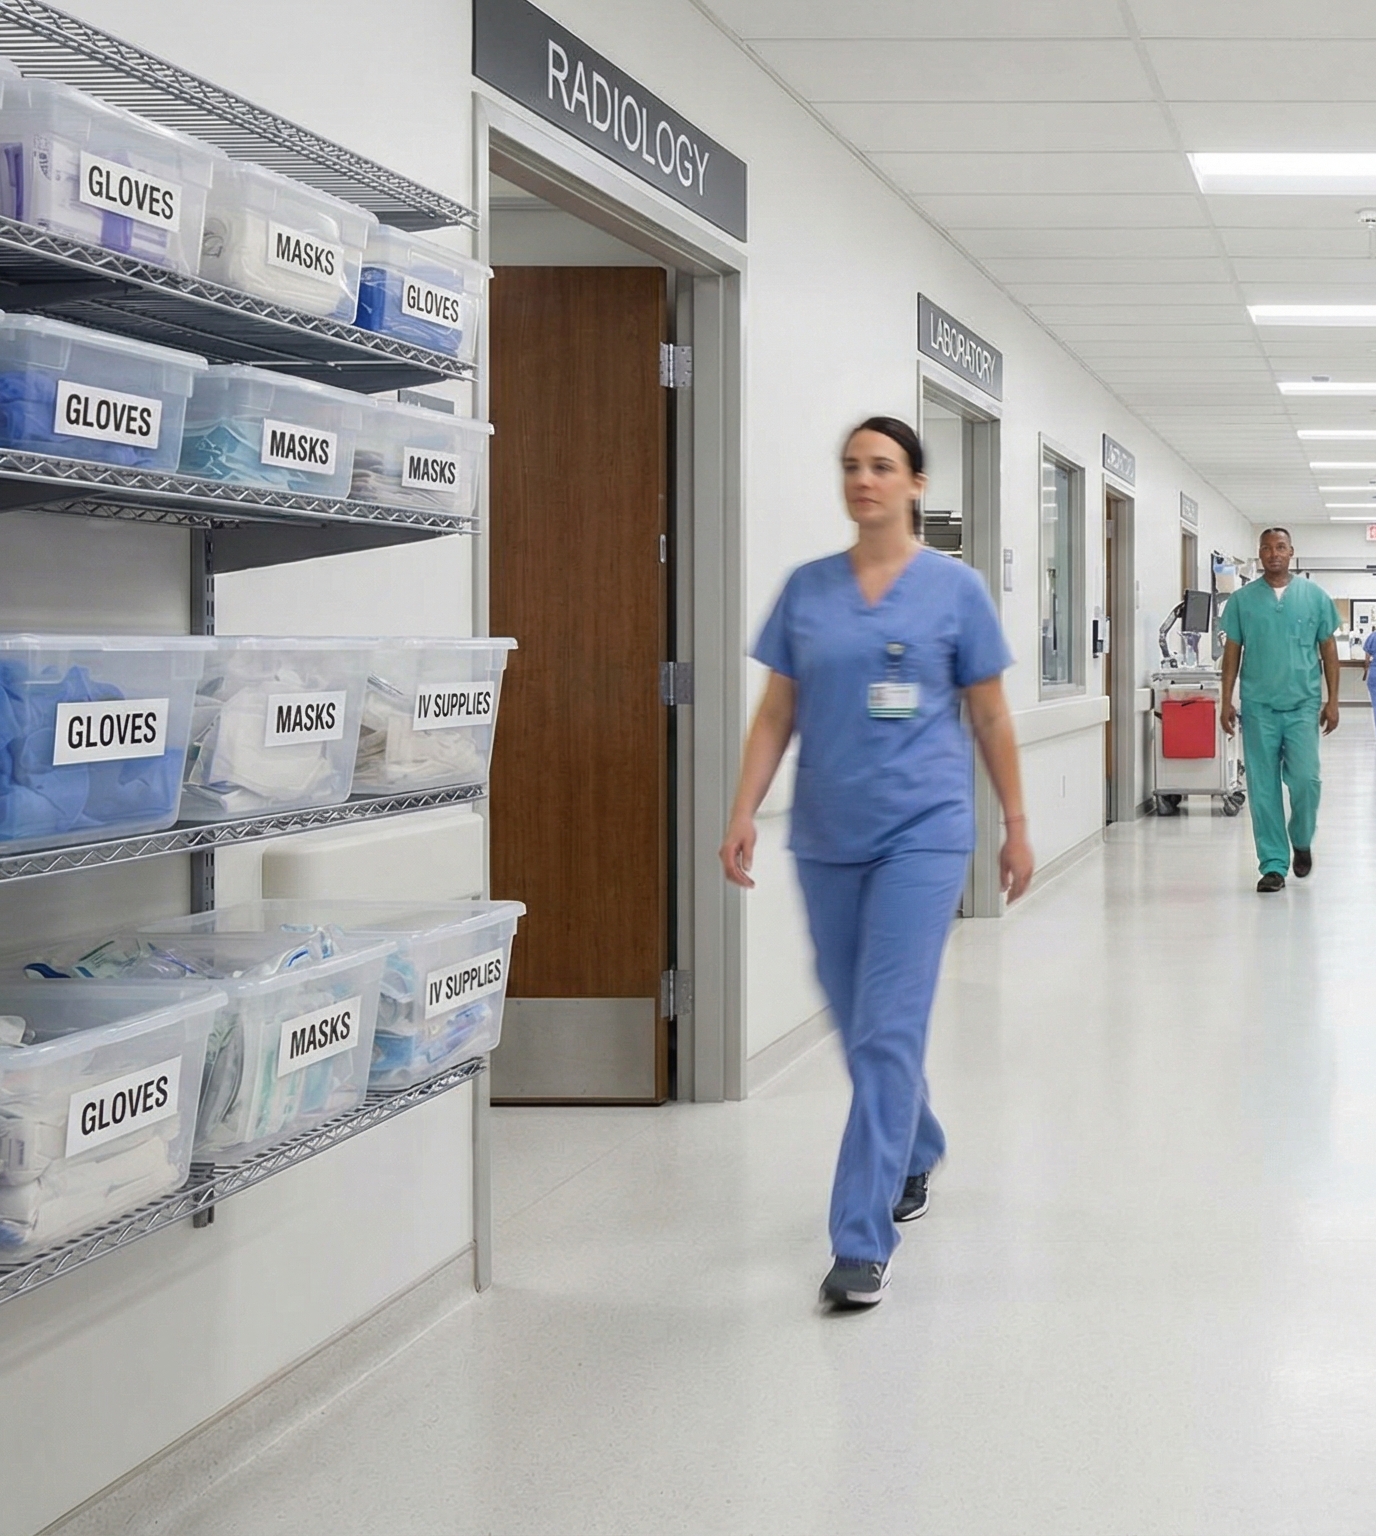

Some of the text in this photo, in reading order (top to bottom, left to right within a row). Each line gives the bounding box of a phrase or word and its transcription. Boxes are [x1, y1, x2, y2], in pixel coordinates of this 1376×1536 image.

[546, 38, 711, 197] RADIOLOGY
[88, 165, 173, 221] GLOVES
[276, 232, 335, 276] MASKS
[406, 284, 459, 323] GLOVES
[930, 311, 996, 387] LABORATORY
[65, 393, 152, 437] GLOVES
[269, 429, 330, 466] MASKS
[408, 455, 456, 485] MASKS
[275, 702, 336, 734] MASKS
[417, 691, 491, 719] IV SUPPLIES
[67, 711, 157, 750] GLOVES
[429, 958, 502, 1006] IV SUPPLIES
[289, 1011, 351, 1060] MASKS
[81, 1075, 169, 1136] GLOVES
